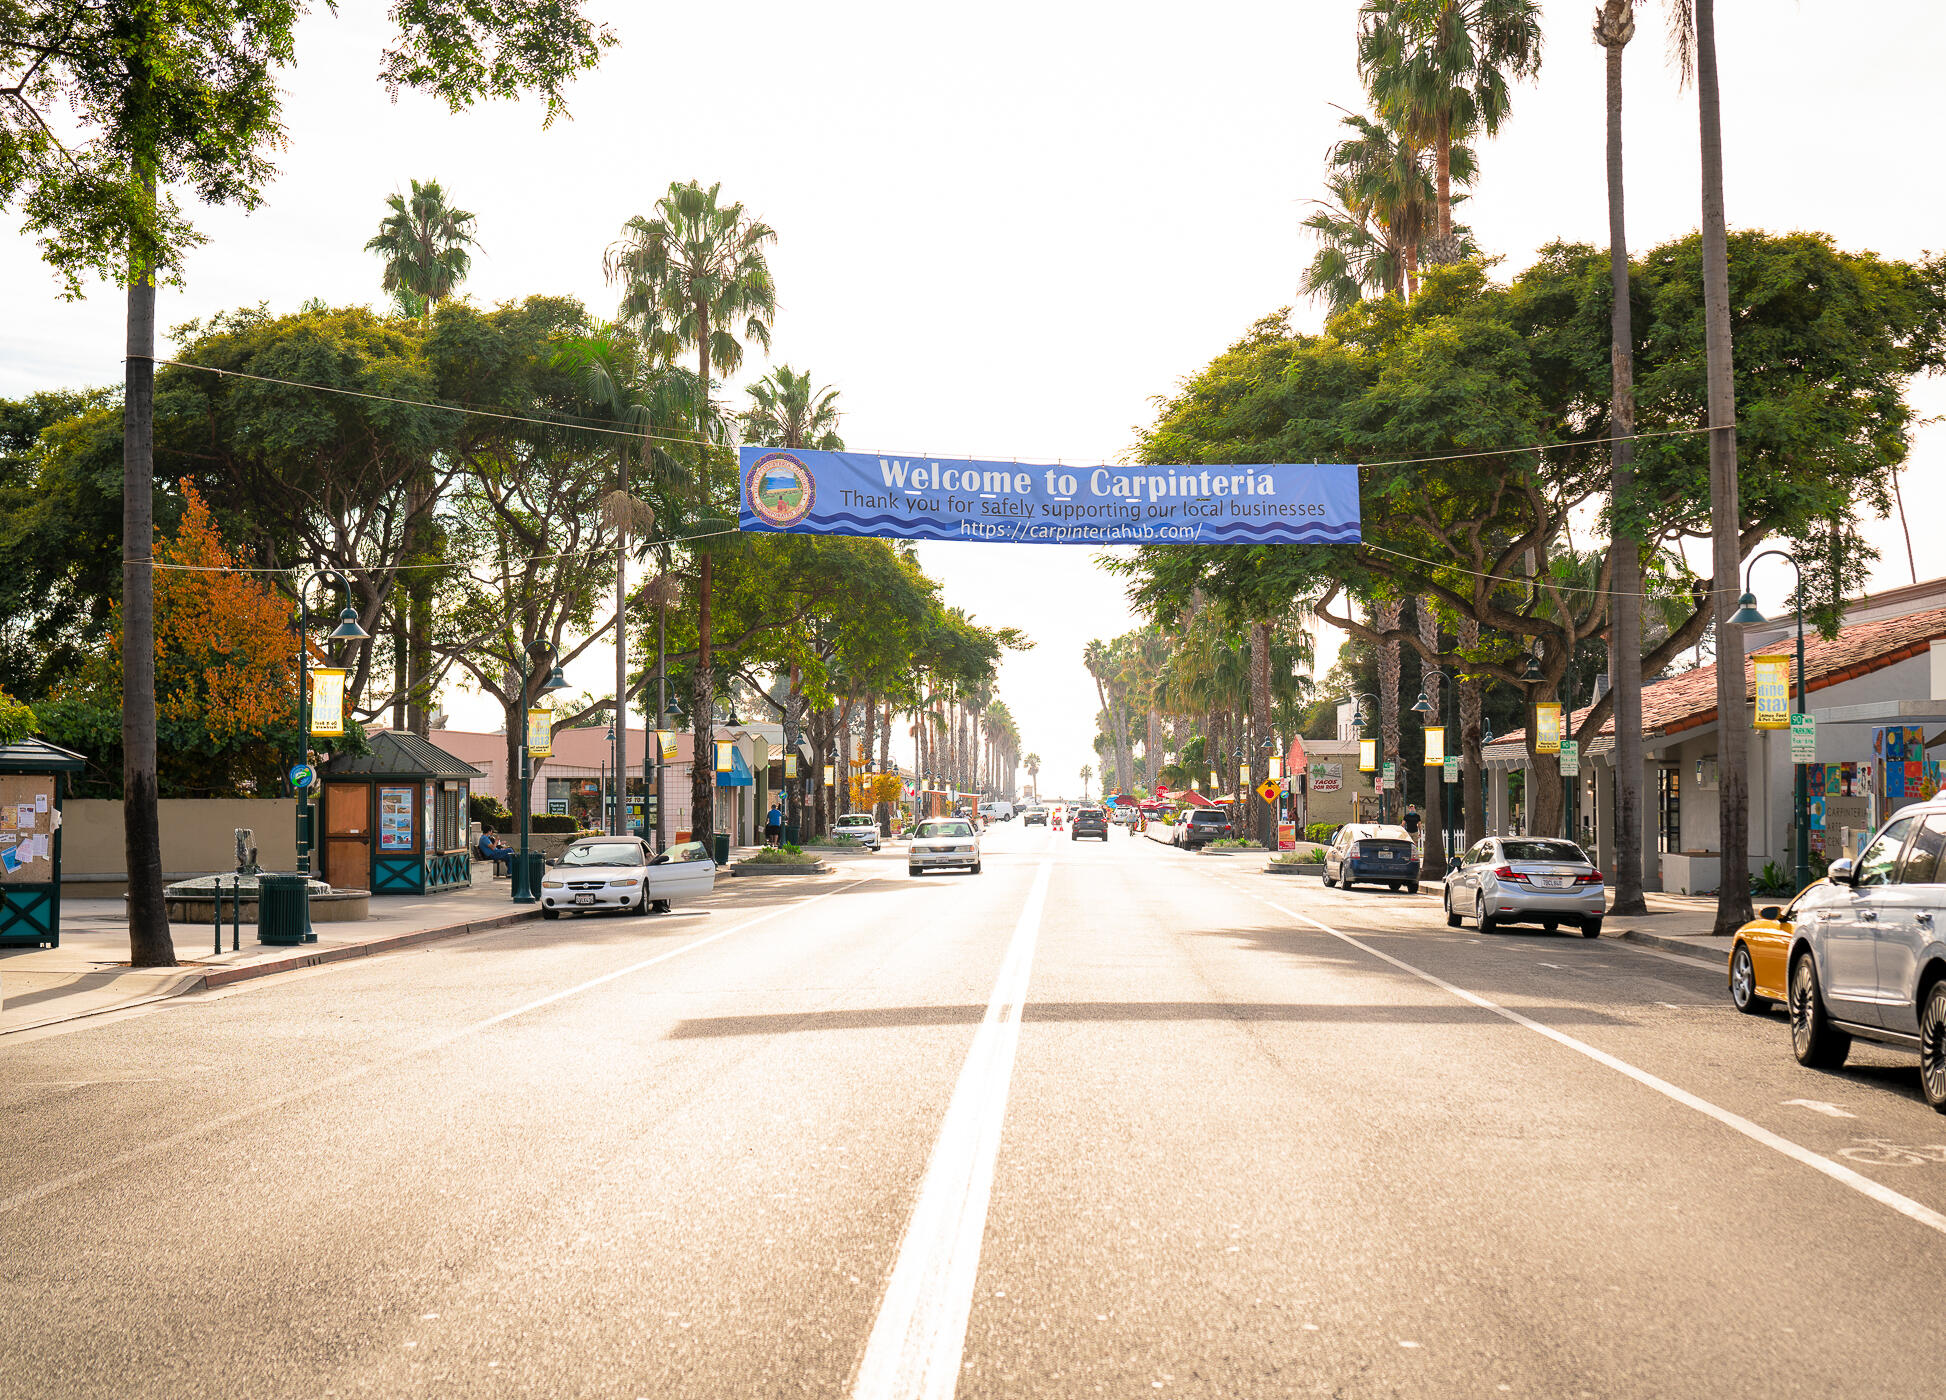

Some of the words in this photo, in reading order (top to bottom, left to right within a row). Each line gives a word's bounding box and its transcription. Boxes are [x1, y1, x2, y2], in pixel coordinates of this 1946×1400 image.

[879, 459, 1032, 495] Welcome
[1044, 468, 1078, 496] to
[1090, 468, 1276, 502] Carpinteria
[840, 490, 899, 509] Thank
[906, 498, 940, 514] you
[948, 495, 974, 513] for
[981, 498, 1035, 517] safely
[1041, 501, 1141, 521] supporting
[1147, 504, 1177, 518] our
[1183, 500, 1223, 517] local
[1231, 499, 1326, 516] businesses
[960, 519, 1203, 542] https://carpinteriahub.com/
[1758, 684, 1784, 697] dine
[1758, 697, 1788, 712] stay
[1791, 715, 1802, 725] 90
[1827, 807, 1869, 818] CARPINTERIA
